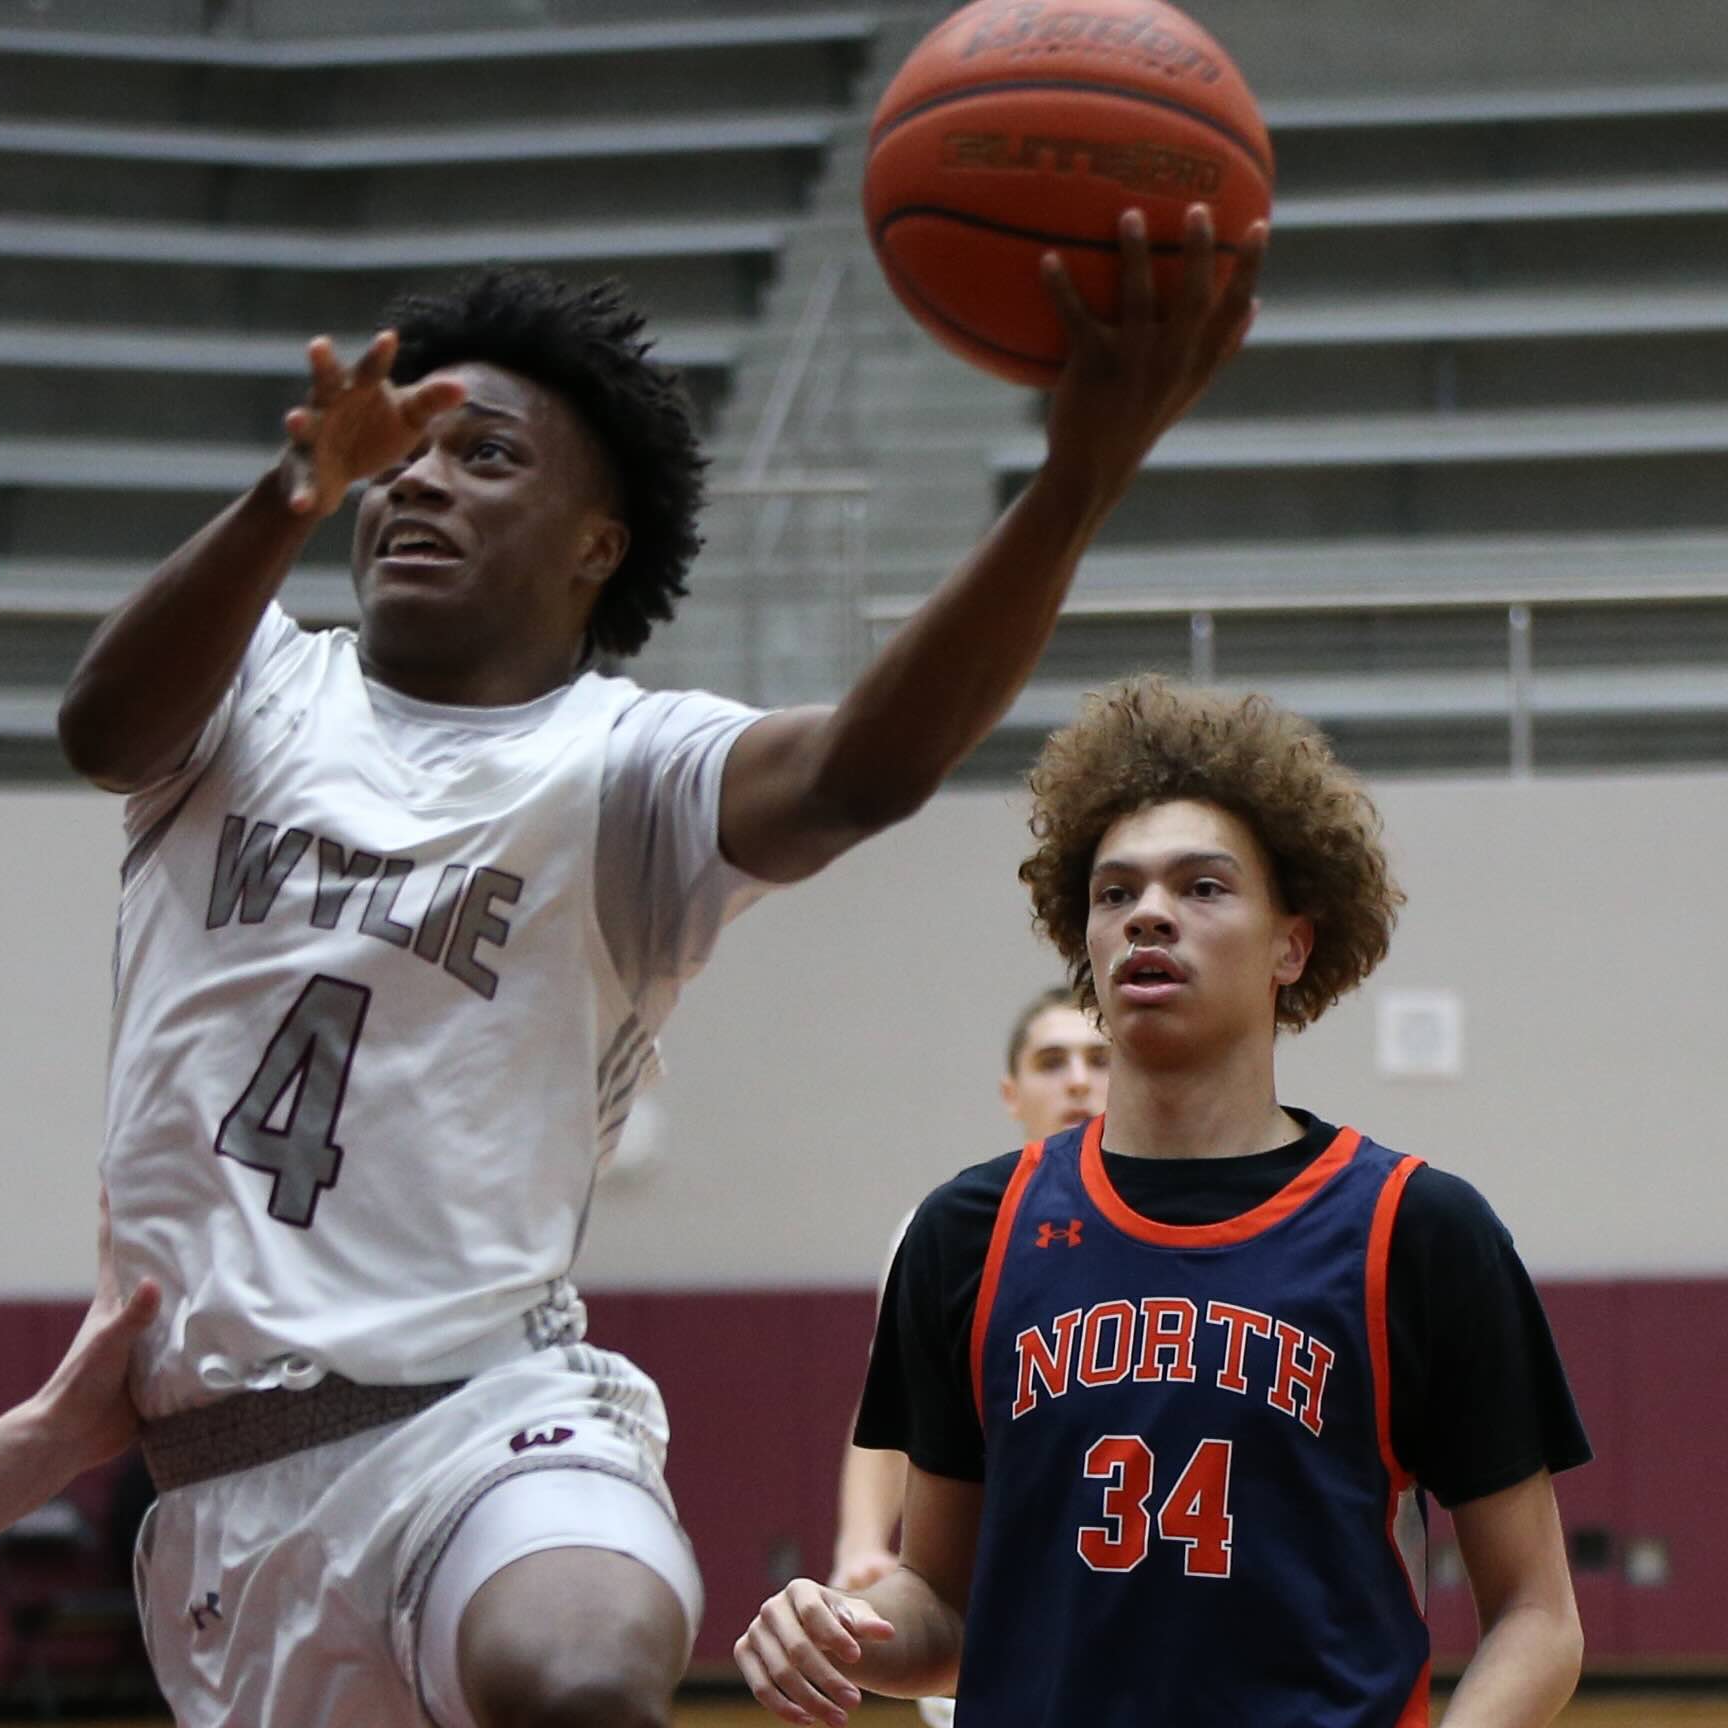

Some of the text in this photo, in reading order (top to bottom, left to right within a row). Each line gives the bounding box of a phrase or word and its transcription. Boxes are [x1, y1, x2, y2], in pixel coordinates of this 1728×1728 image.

[205, 815, 524, 1000] WYLIE
[214, 974, 372, 1228] 4
[1013, 1298, 1335, 1437] NORTH
[1077, 1435, 1233, 1578] 34
